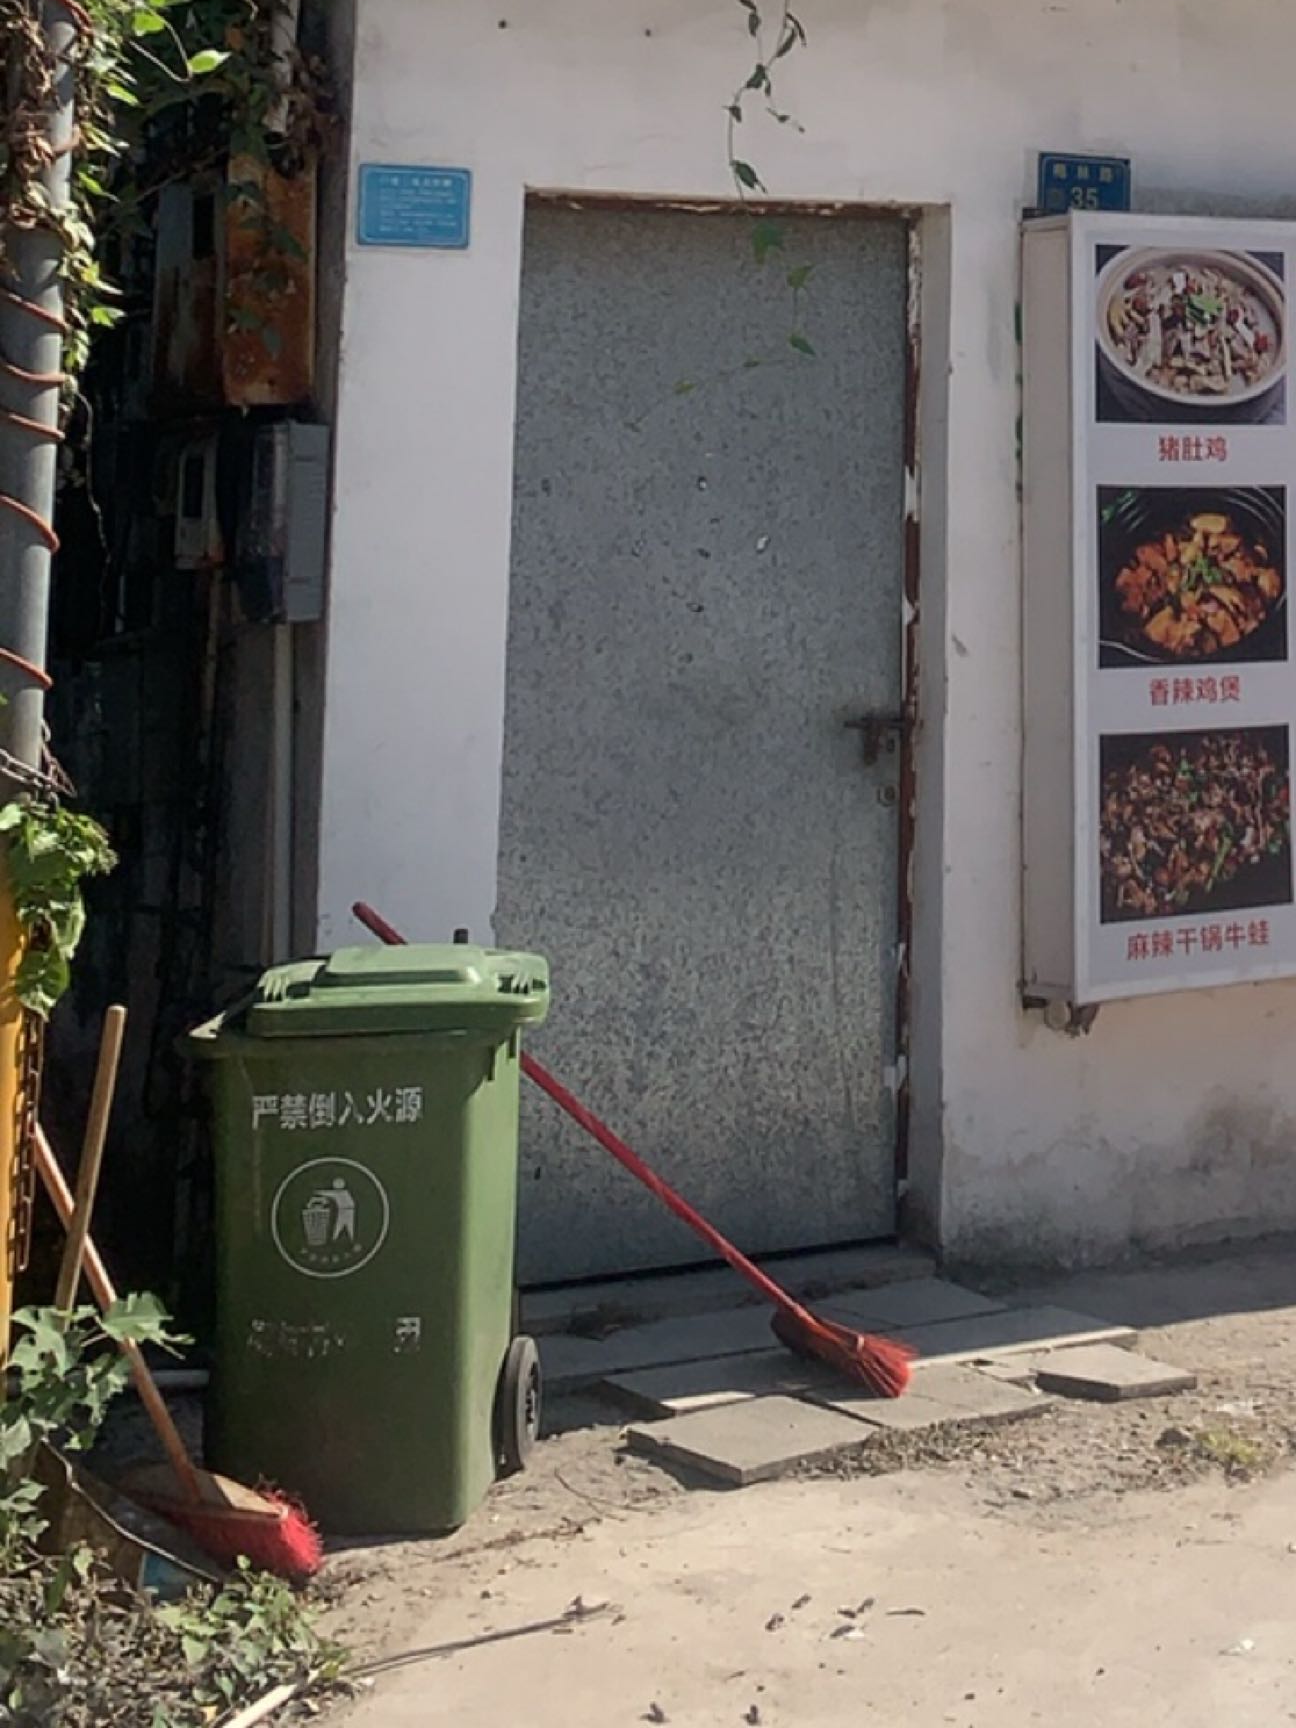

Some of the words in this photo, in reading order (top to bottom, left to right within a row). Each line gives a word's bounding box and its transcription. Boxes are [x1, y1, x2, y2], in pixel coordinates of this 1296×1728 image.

[1159, 435, 1227, 461] 猪肚鸡
[1150, 675, 1240, 706] 香辣鸡煲
[1127, 920, 1270, 960] 麻辣干锅牛蛙
[252, 1086, 424, 1130] 严禁倒入火源
